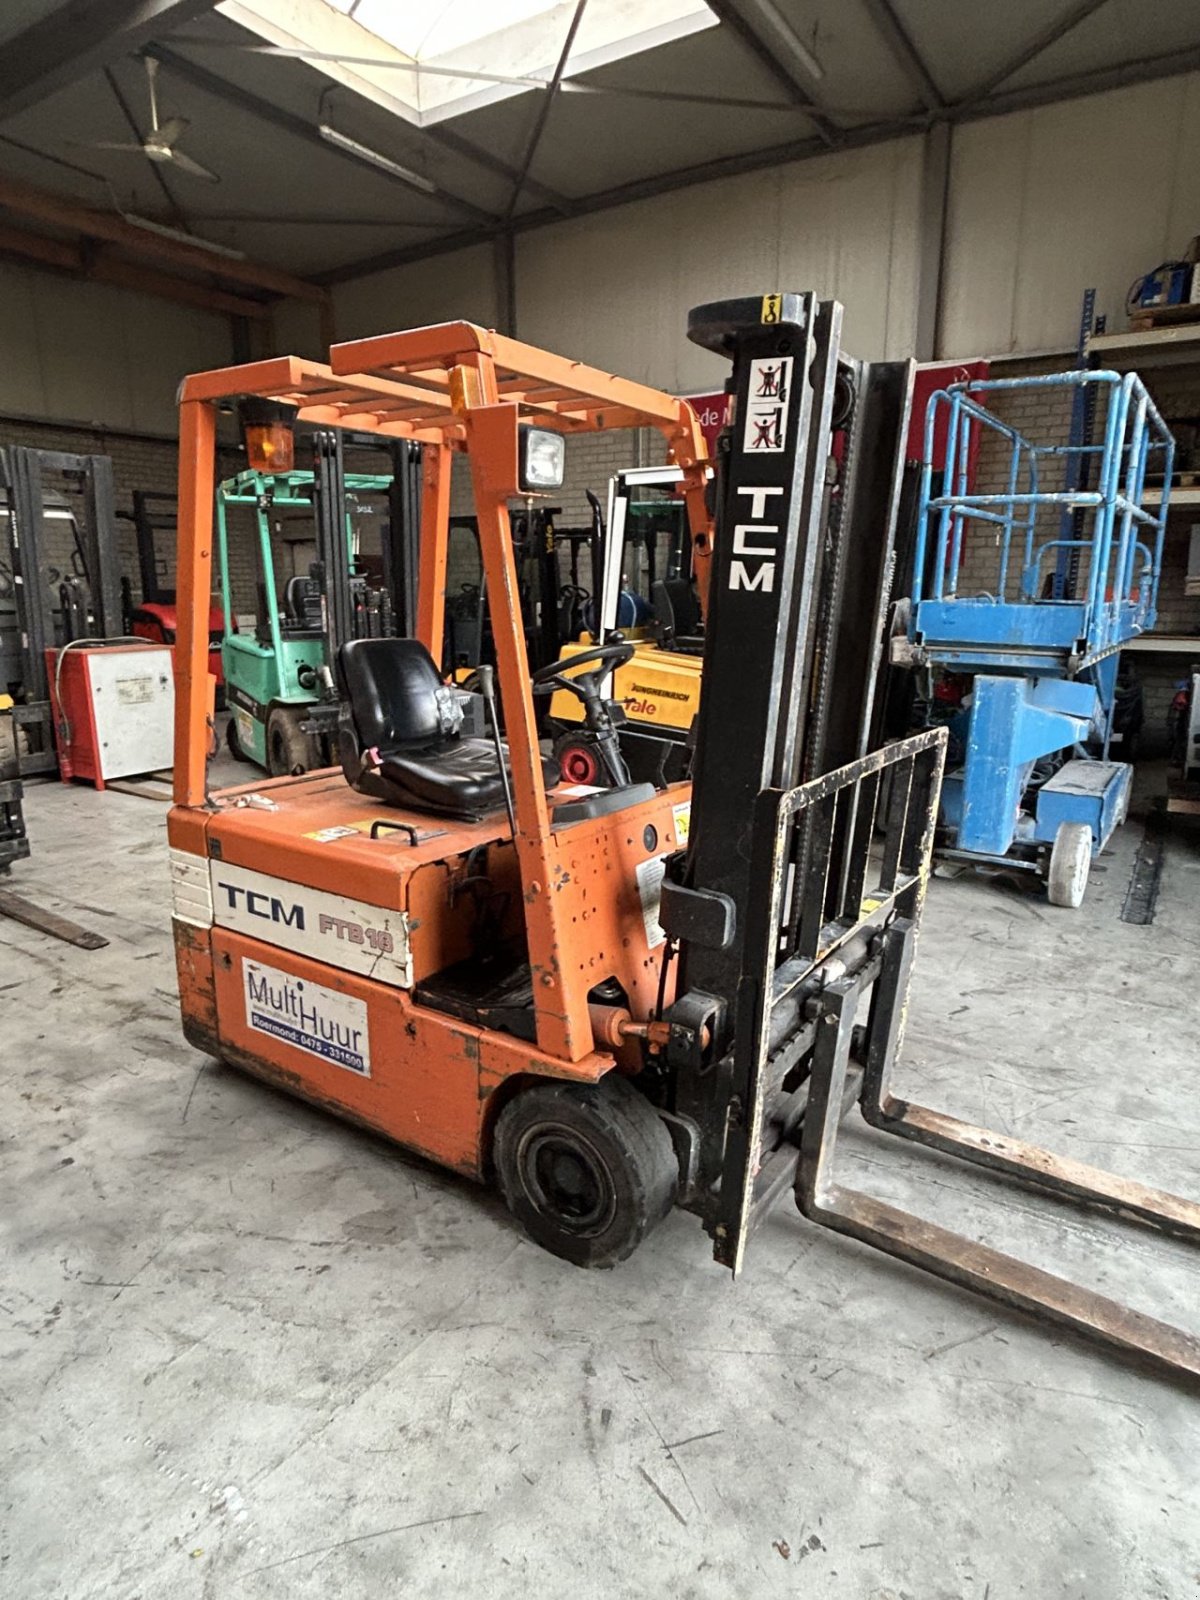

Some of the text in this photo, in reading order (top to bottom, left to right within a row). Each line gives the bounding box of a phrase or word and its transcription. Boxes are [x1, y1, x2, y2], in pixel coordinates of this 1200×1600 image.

[728, 486, 784, 592] TCM
[631, 683, 690, 702] JUNGHEINRICH
[218, 882, 394, 953] TCM FTB18
[252, 1015, 299, 1042] Roermond:
[300, 1035, 322, 1052] 0475
